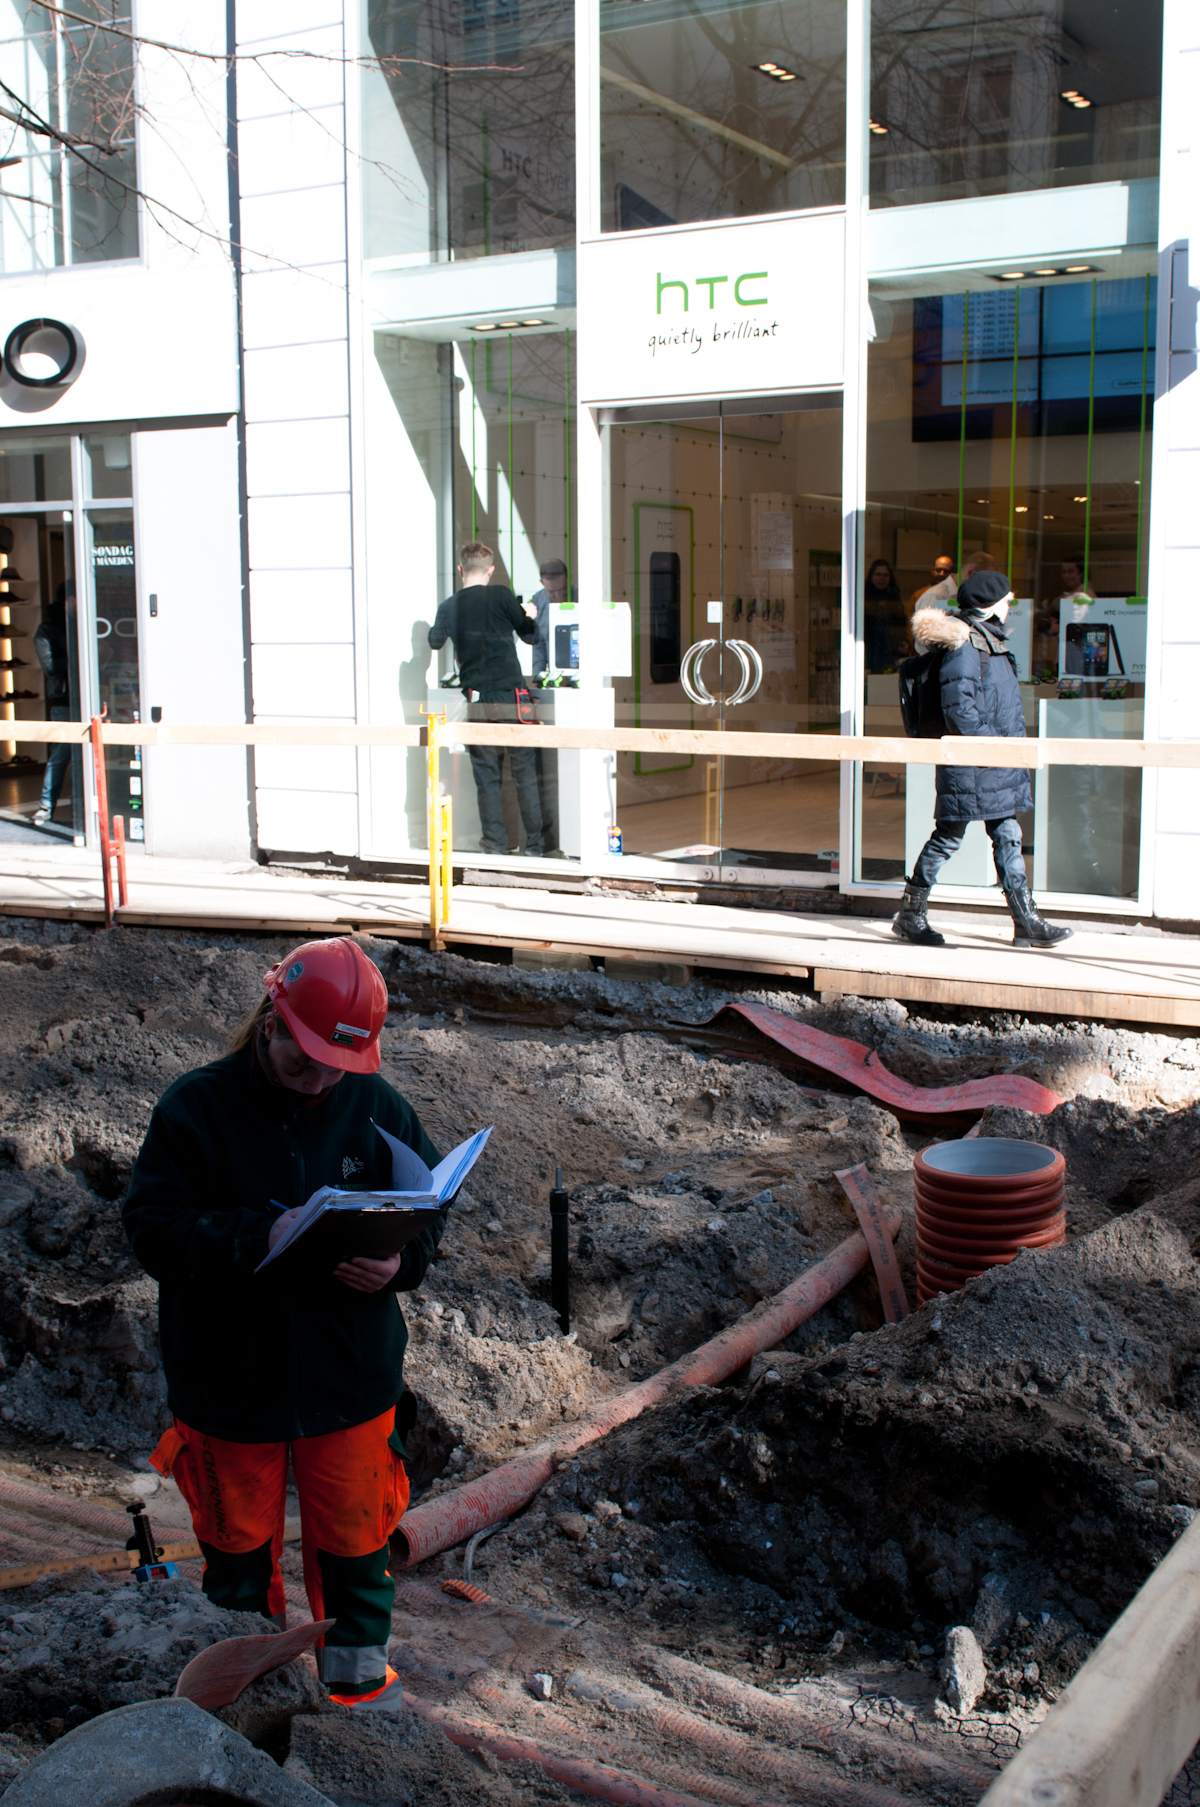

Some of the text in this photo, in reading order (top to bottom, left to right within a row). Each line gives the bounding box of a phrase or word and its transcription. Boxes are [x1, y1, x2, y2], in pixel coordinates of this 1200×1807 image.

[502, 148, 570, 192] HTC Flyer
[648, 318, 779, 358] quietly brilliant
[342, 1026, 368, 1036] CHRISTINE
